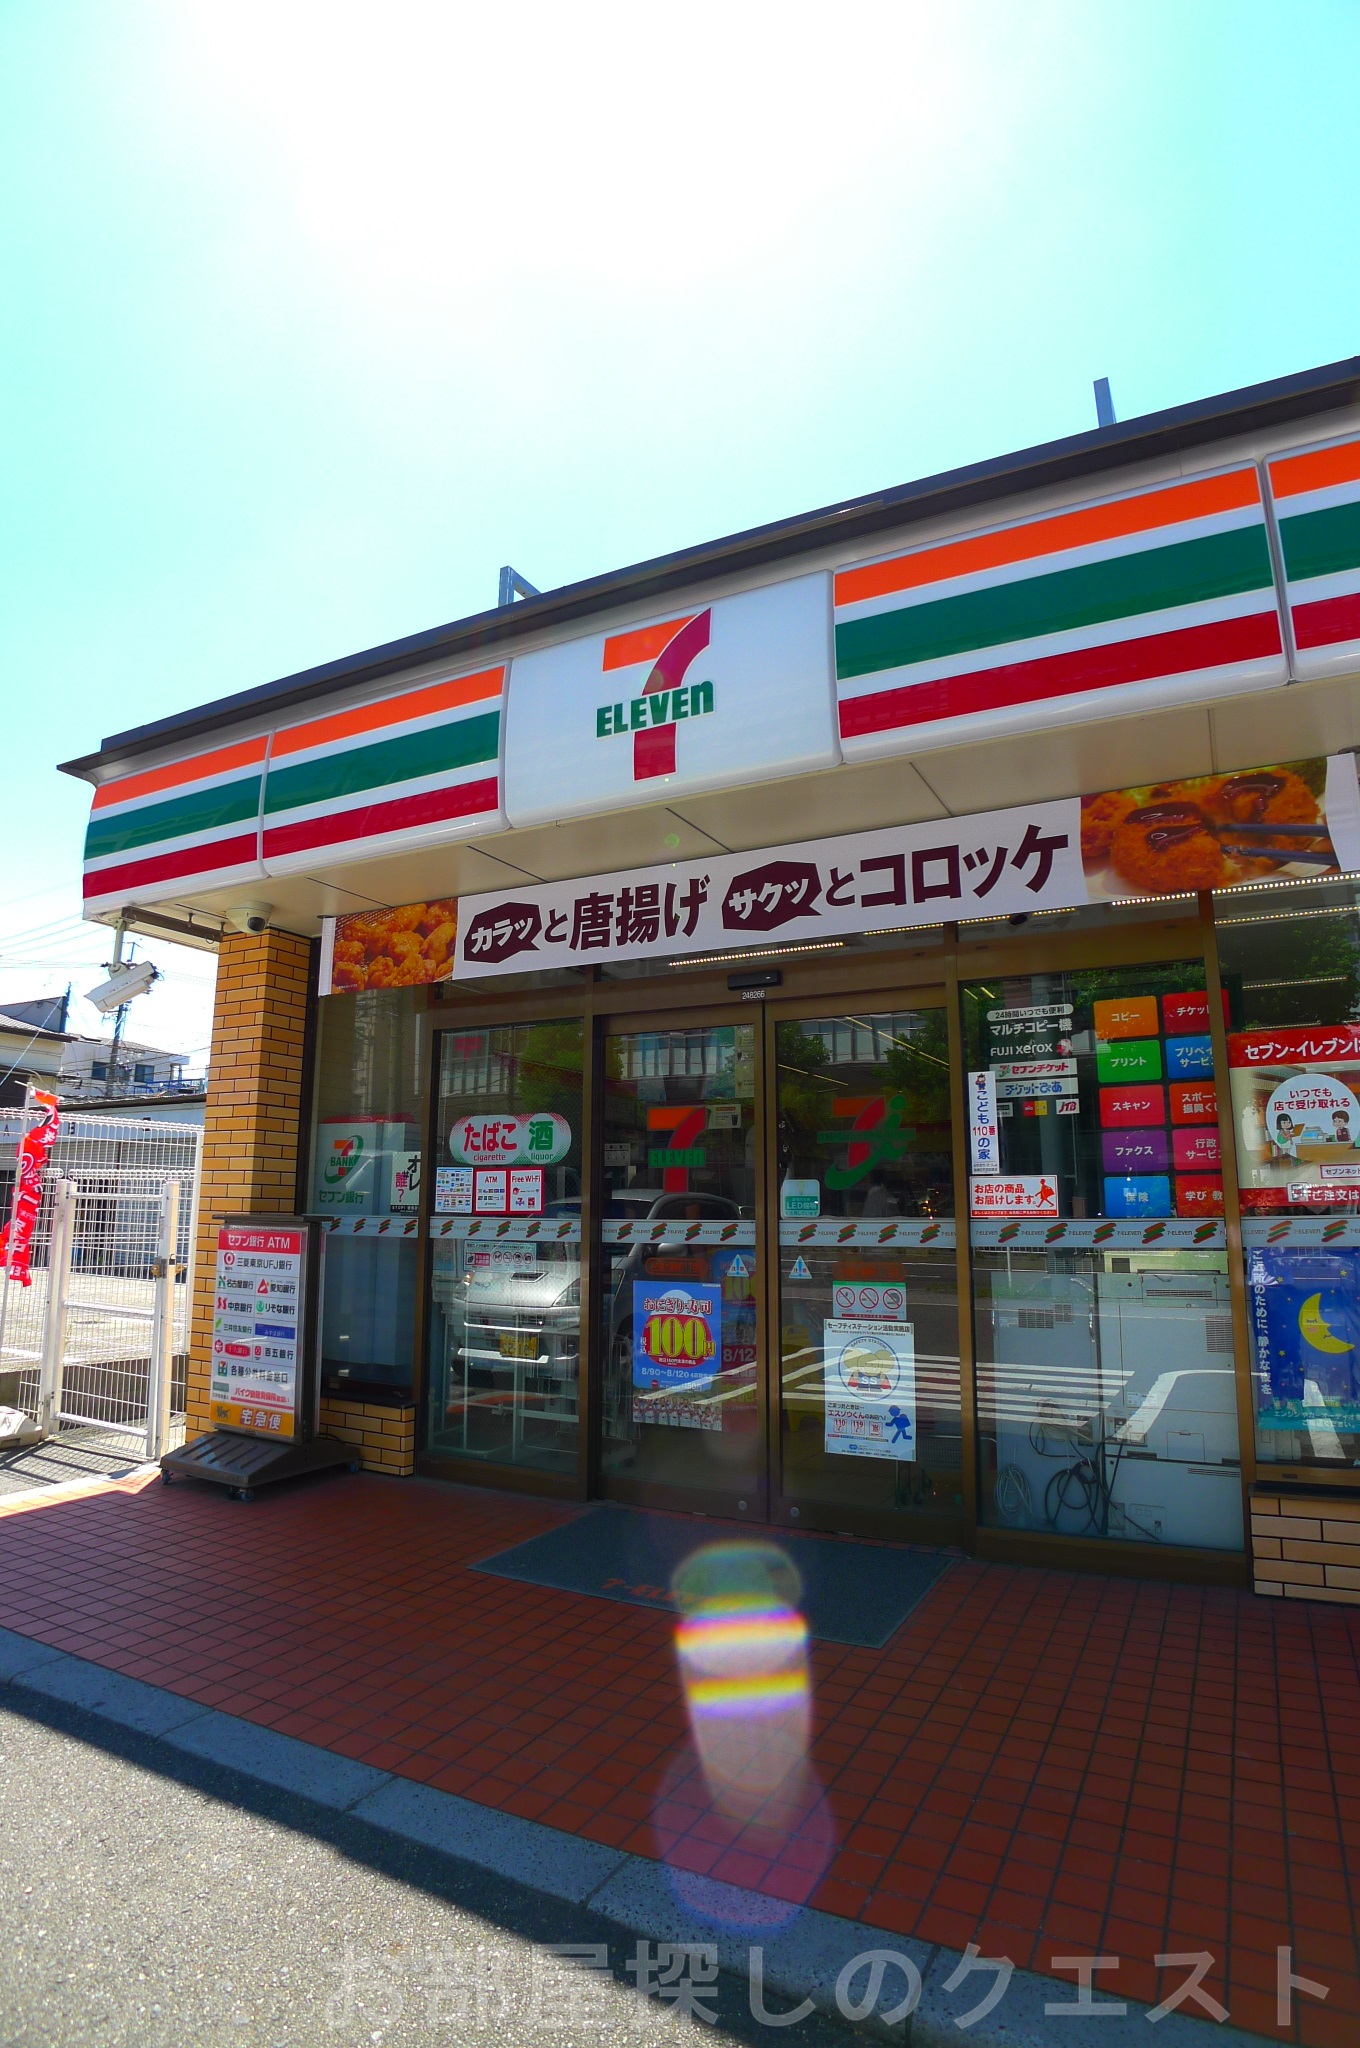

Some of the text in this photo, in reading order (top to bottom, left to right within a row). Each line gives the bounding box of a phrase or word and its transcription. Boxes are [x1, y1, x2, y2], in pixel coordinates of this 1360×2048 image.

[742, 990, 765, 1000] 248266
[996, 1005, 1064, 1019] 24時間いつでも便利
[1111, 1012, 1140, 1022] コピー
[990, 1018, 1072, 1036] マルチコピー機
[990, 1047, 1013, 1056] FUJI
[1110, 1056, 1146, 1068] プリント
[1012, 1062, 1068, 1074] セブンチケット
[1005, 1081, 1062, 1096] チケットぴあ
[1290, 1088, 1332, 1099] いつでも
[1182, 1092, 1217, 1102] スポー
[1059, 1102, 1076, 1113] JTB
[1112, 1101, 1150, 1111] スキャン
[1274, 1098, 1350, 1111] 店で受け取れる
[973, 1090, 996, 1160] こども110番の家
[464, 1120, 554, 1152] たばこ 酒
[1195, 1138, 1216, 1149] 行政
[1115, 1146, 1153, 1156] ファクス
[330, 1157, 355, 1167] BANK
[473, 1152, 553, 1162] cigarette liquor
[974, 1184, 1025, 1193] お店の商品
[319, 1190, 364, 1204] セブン銀行
[974, 1195, 1037, 1205] お届けします。
[1186, 1191, 1207, 1201] 学び
[228, 1234, 290, 1248] セブン銀行 ATM
[236, 1258, 292, 1270] 三菱東京UFJ銀行
[227, 1279, 295, 1294] 名古屋銀行 愛知銀行
[228, 1302, 295, 1315] 中京銀行 りそな銀行
[223, 1323, 252, 1334] 三井住友銀行
[265, 1348, 294, 1360] 百五銀行
[242, 1409, 281, 1430] 宅急便
